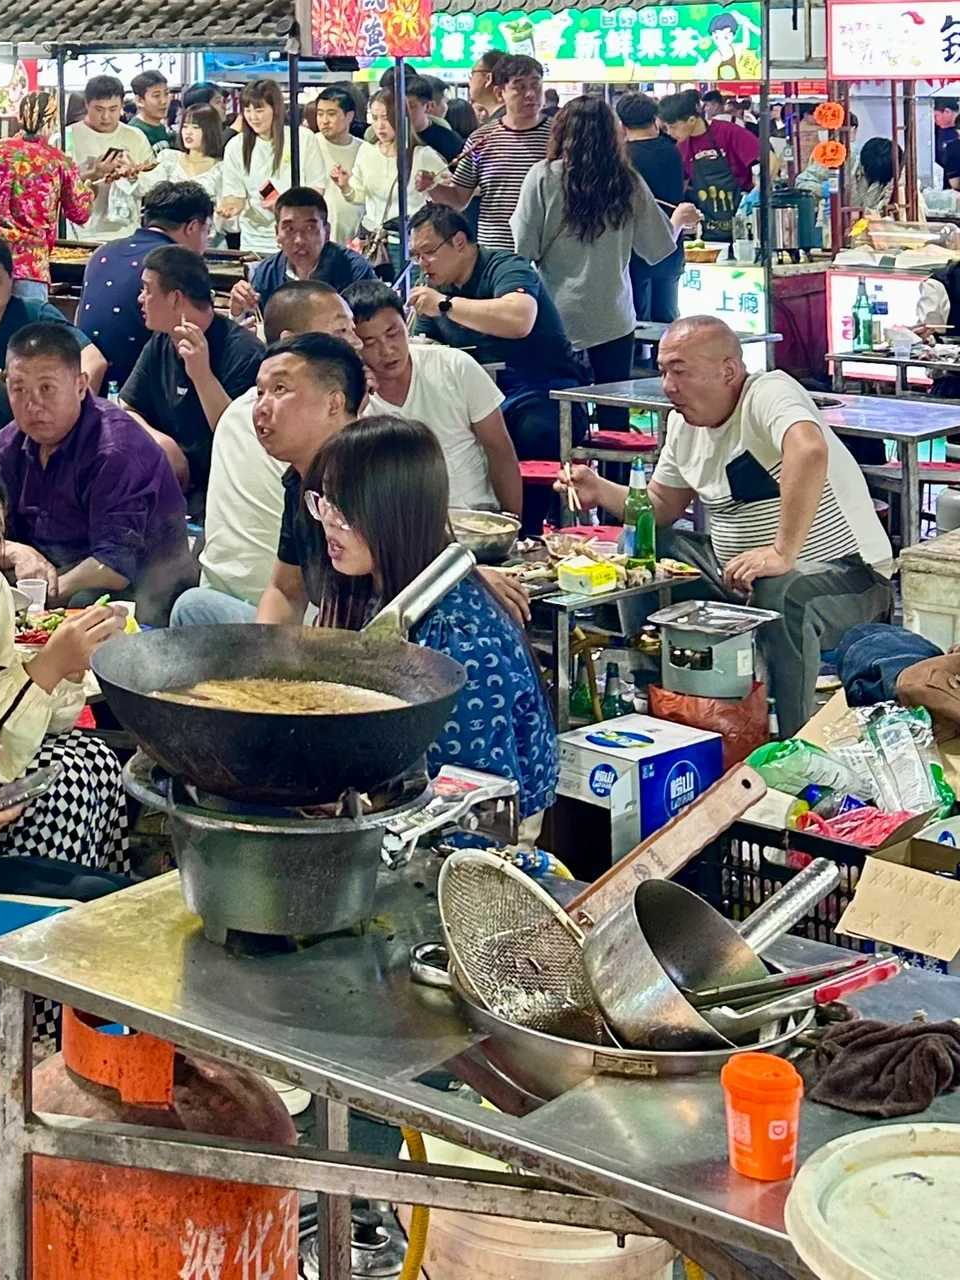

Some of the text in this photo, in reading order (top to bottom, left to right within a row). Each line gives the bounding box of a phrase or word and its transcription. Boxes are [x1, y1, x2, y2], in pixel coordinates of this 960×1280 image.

[574, 27, 699, 59] 新鲜果茶
[716, 290, 759, 314] 上瘾
[670, 771, 694, 797] 崂山
